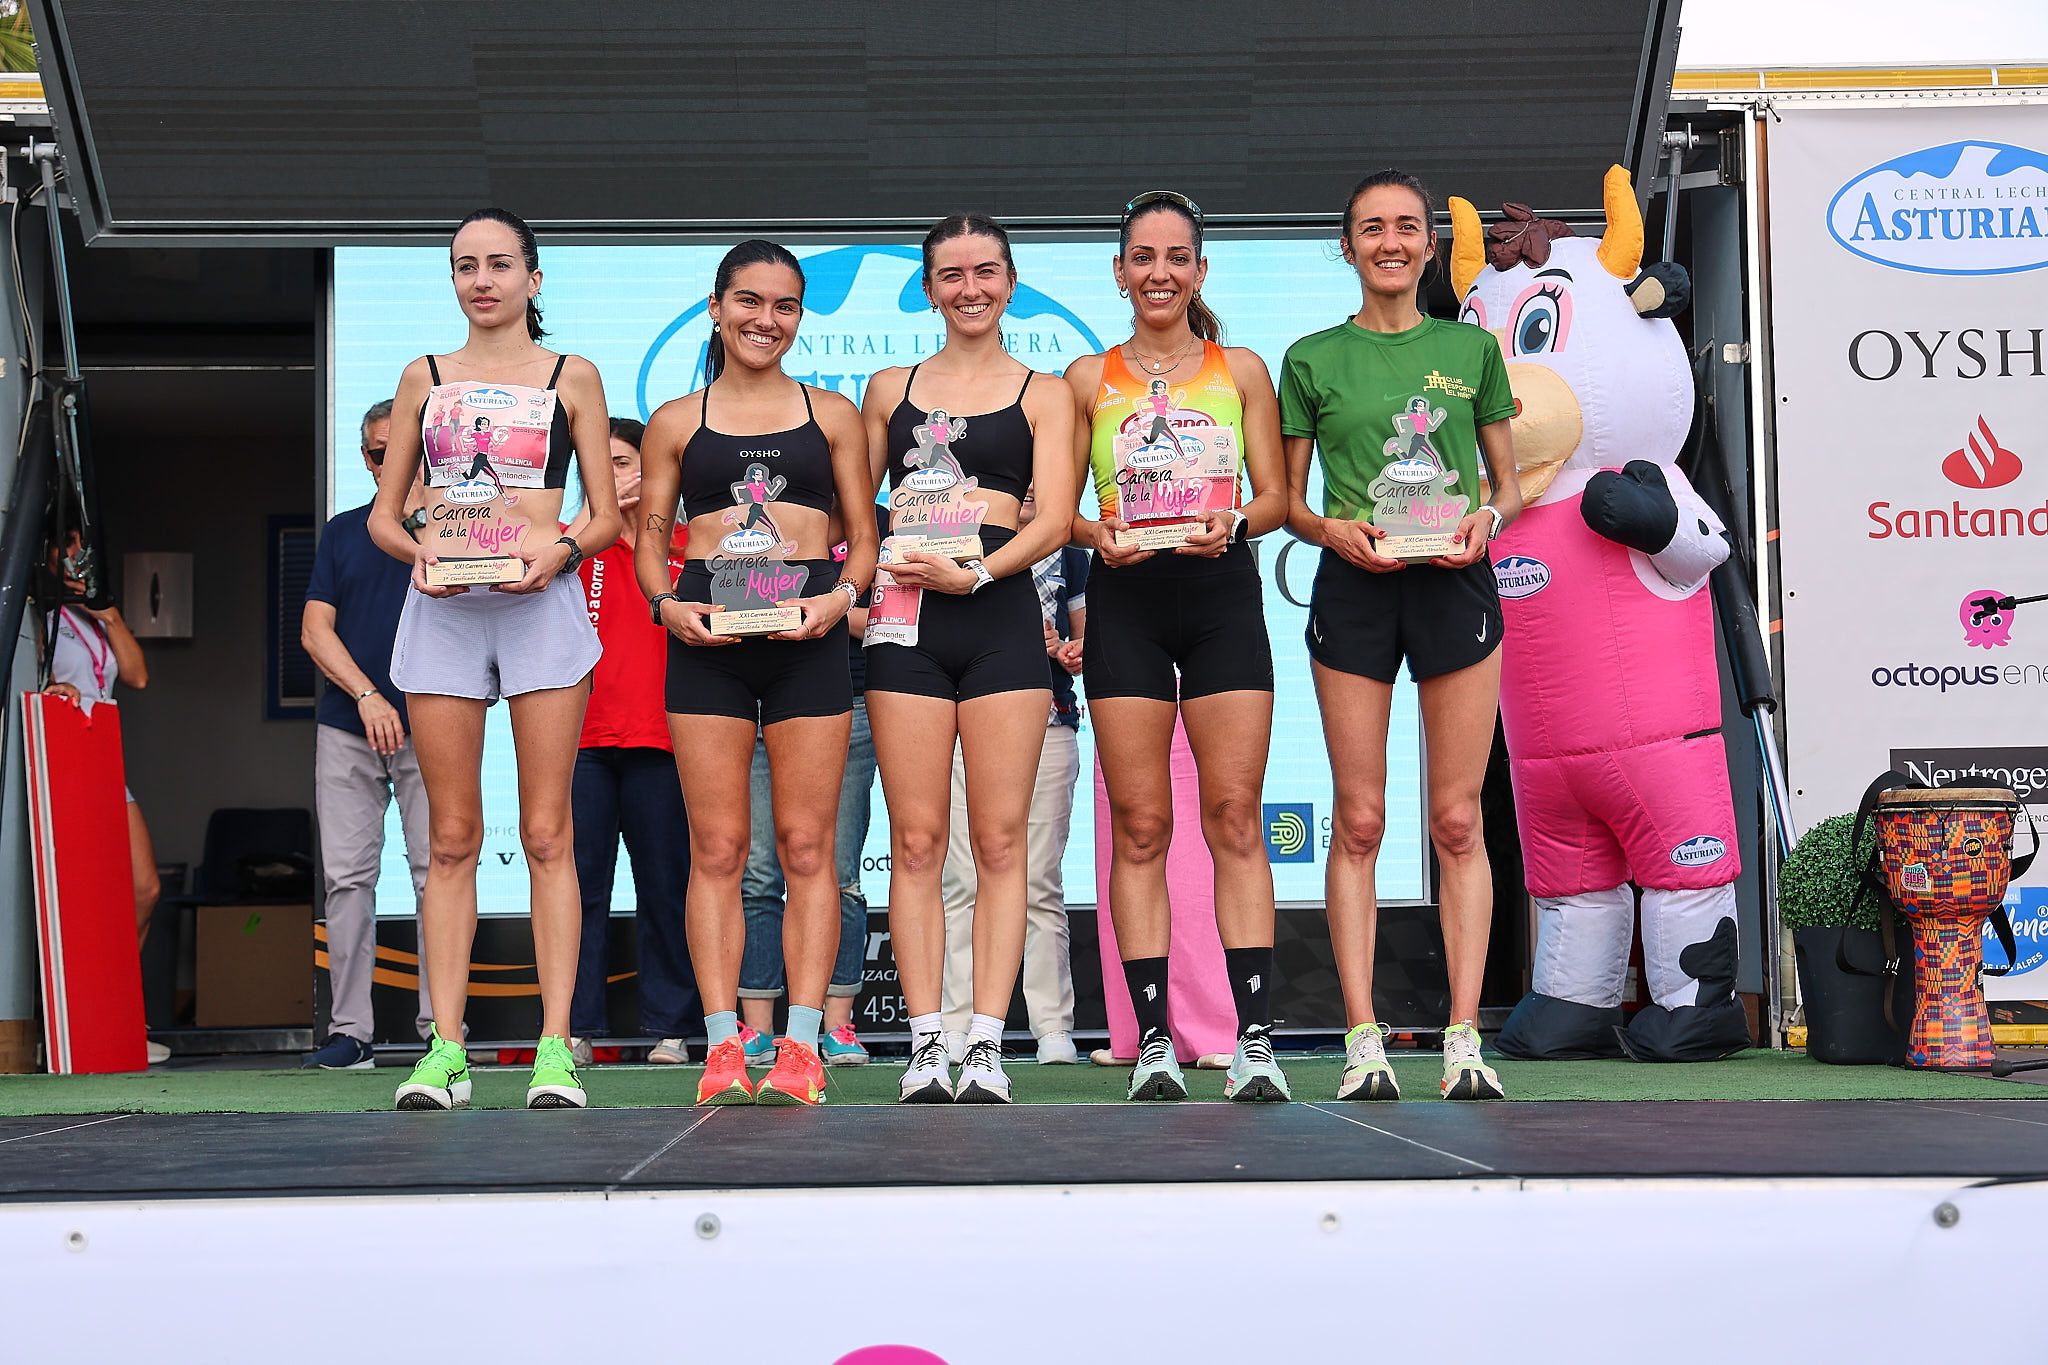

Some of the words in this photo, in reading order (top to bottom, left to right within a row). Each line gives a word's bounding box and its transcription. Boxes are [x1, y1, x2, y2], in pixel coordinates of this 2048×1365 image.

[1894, 188, 1985, 200] CENTRAL
[1849, 192, 2048, 241] ASTURIA
[797, 334, 896, 355] NTRAL
[466, 395, 514, 406] ASTURIANA
[504, 458, 532, 466] VALENCIA
[740, 450, 780, 458] OYSHO
[1130, 454, 1173, 465] ASTURIANA
[1116, 468, 1173, 485] Carrera
[1391, 468, 1434, 477] ASTURIANA
[910, 477, 951, 486] ASTURIANA
[450, 490, 493, 499] ASTURIANA
[1124, 488, 1137, 502] de
[1140, 488, 1150, 501] la
[1151, 479, 1208, 516] Mujer
[1374, 483, 1430, 498] Carrera
[894, 492, 950, 508] Carrera
[432, 504, 492, 520] Carrera
[902, 510, 914, 524] de
[918, 509, 928, 522] la
[927, 501, 984, 536] Mujer
[1381, 501, 1394, 515] de
[1398, 501, 1408, 514] la
[1408, 496, 1465, 529] Mujer
[440, 522, 454, 538] de
[457, 522, 468, 538] la
[466, 517, 526, 554] Mujer
[727, 540, 770, 550] ASTURIANA
[710, 554, 768, 571] Carrera
[590, 558, 604, 598] correr
[718, 572, 732, 588] de
[736, 572, 746, 587] la
[745, 566, 804, 603] Mujer
[1871, 662, 1999, 693] octopus
[1903, 760, 2048, 798] Neutroge
[1676, 847, 1723, 861] ASTURIANA
[2016, 952, 2043, 970] ALPES
